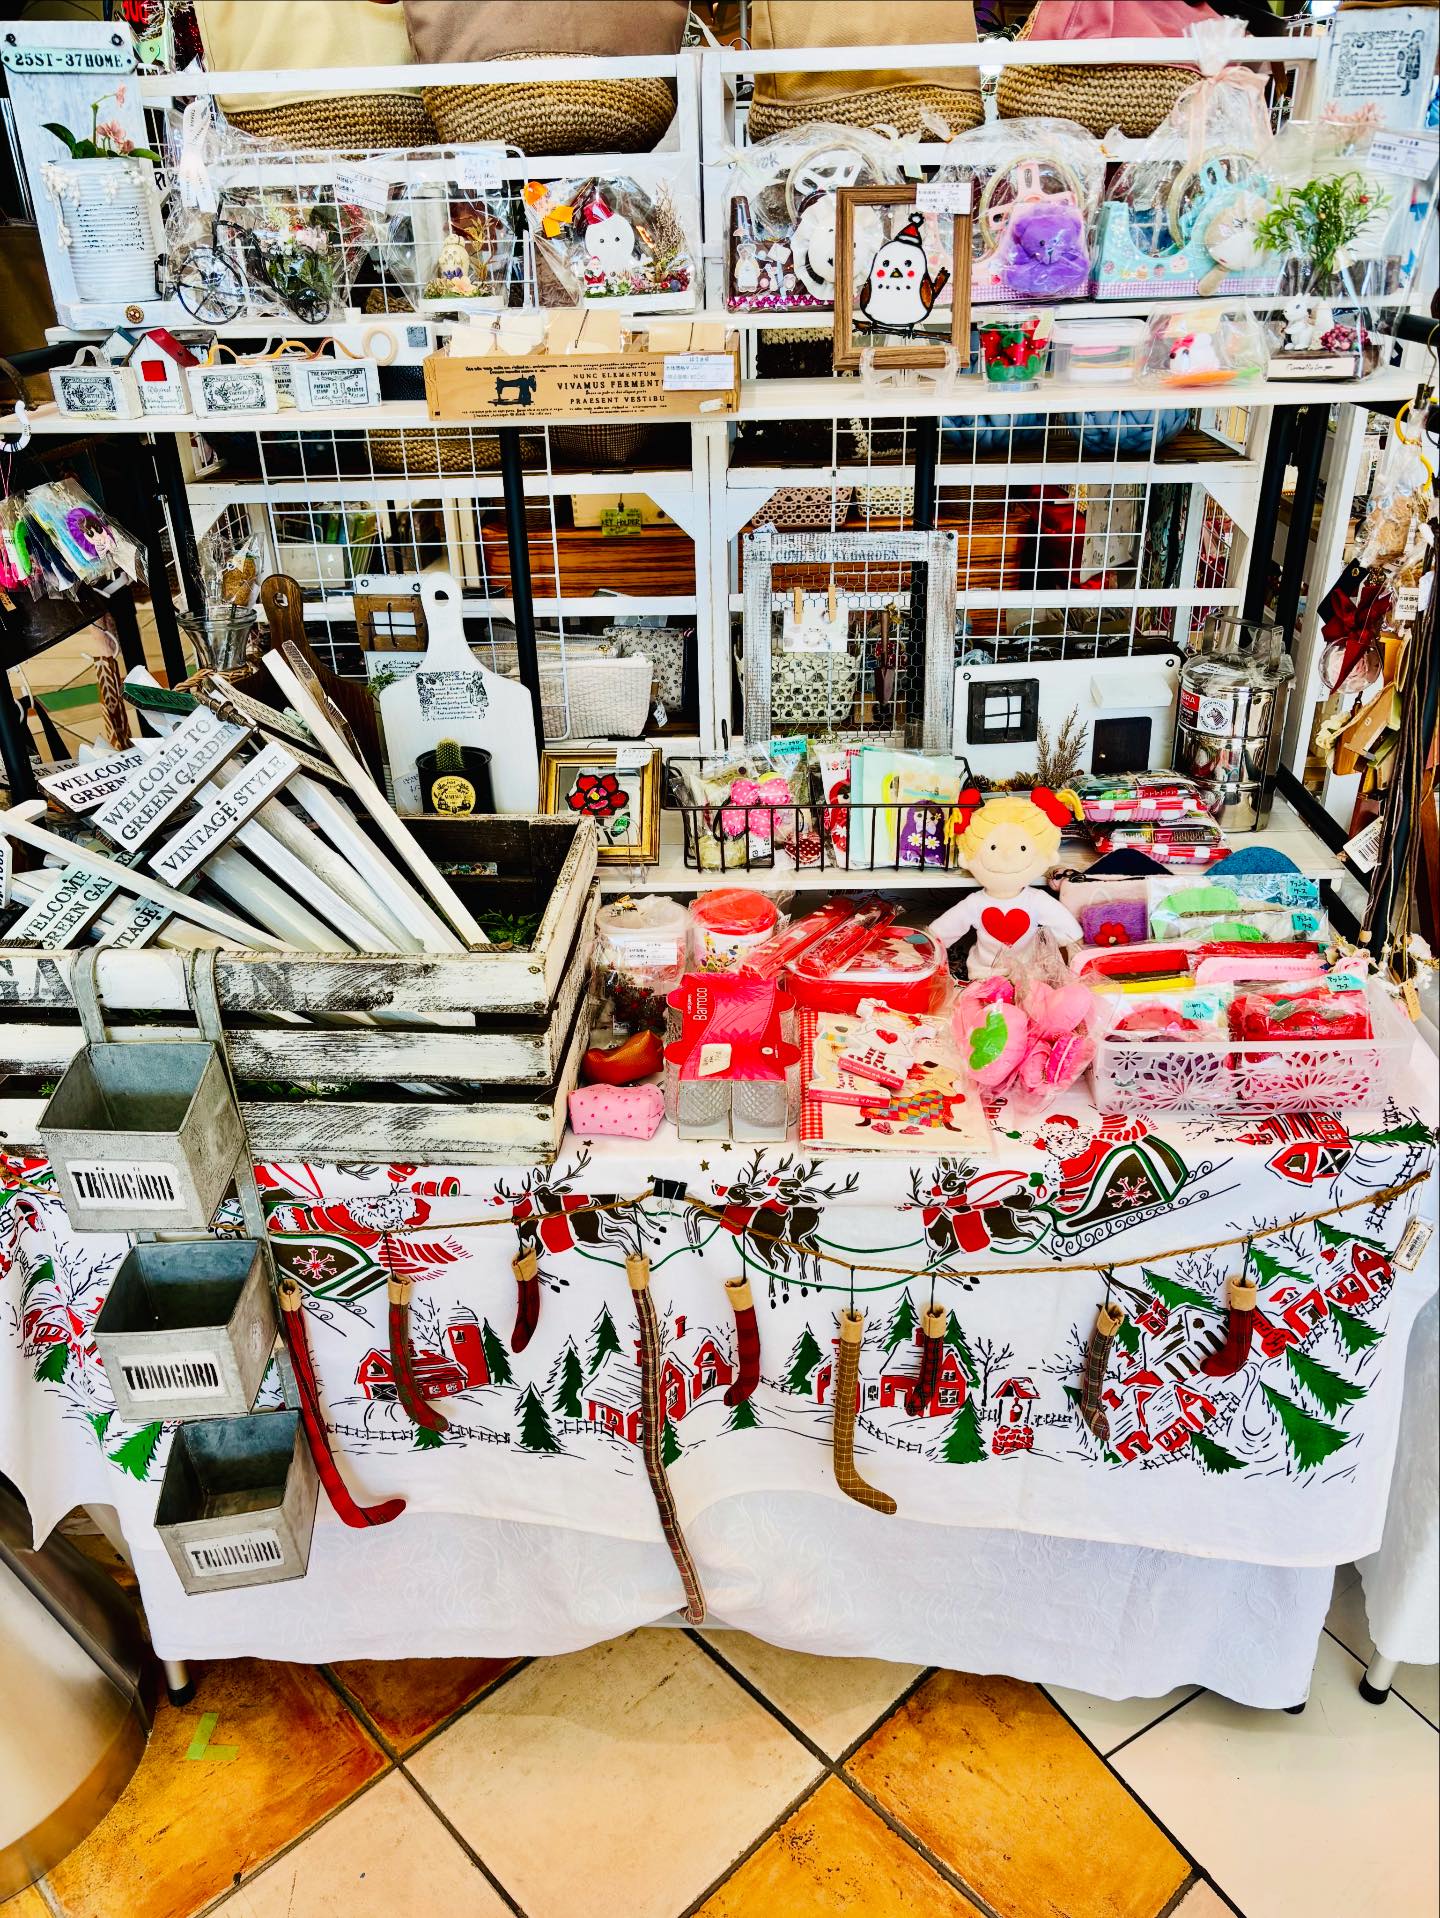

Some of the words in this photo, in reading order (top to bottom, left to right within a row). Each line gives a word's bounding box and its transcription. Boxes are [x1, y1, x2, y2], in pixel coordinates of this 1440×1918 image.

[15, 53, 123, 68] 25ST-37HOME
[557, 382, 605, 390] VIVAMUS
[610, 379, 664, 389] FERMENT
[602, 371, 656, 379] ELEMENTUM
[570, 397, 619, 405] PRAESENT
[751, 549, 806, 562] WELCOME
[811, 549, 827, 561] TO
[850, 549, 900, 561] GARDEN
[103, 743, 189, 827] WELCOME
[183, 719, 211, 744] TO
[121, 783, 178, 841] GREEN
[174, 723, 241, 786] GARDEN
[161, 802, 238, 872] VINTAGE
[233, 755, 287, 807] STYLE
[18, 870, 92, 941] WELCOME
[693, 988, 708, 1021] Barroco
